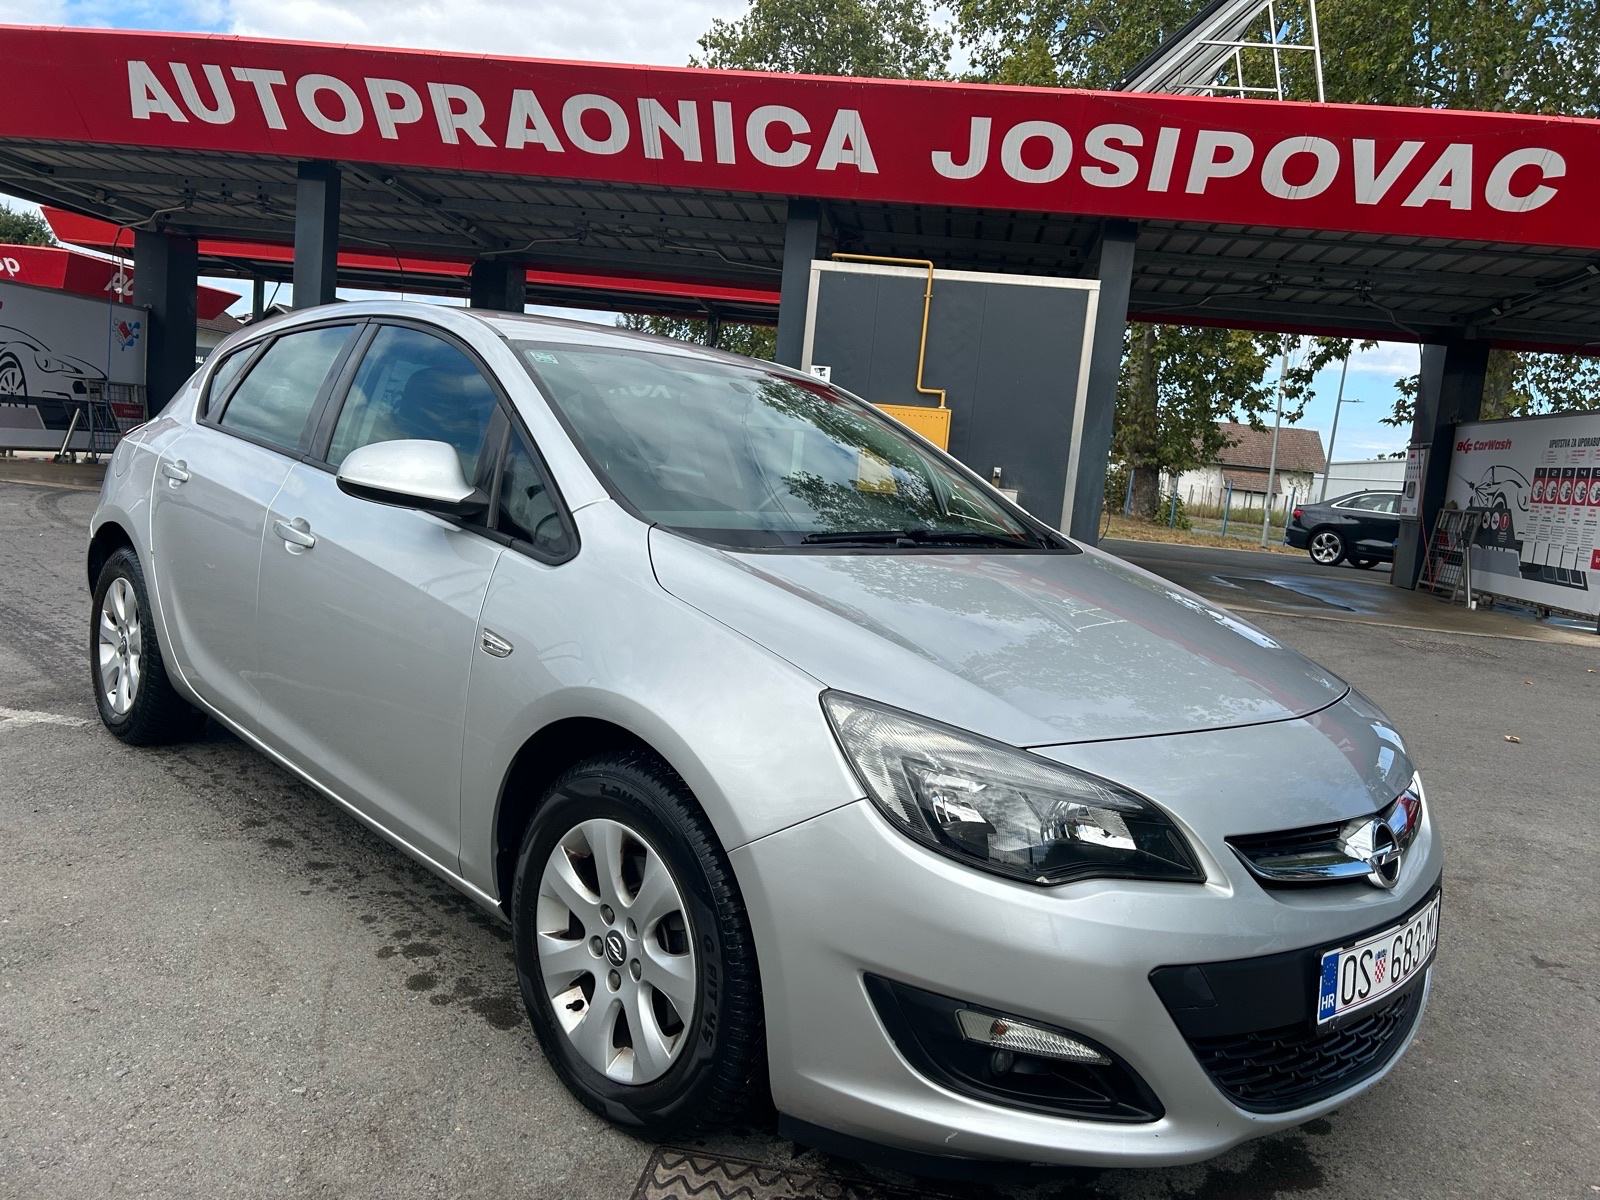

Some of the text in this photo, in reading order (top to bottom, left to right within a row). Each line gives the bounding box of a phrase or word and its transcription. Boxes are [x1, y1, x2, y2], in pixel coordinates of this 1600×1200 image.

[127, 60, 1566, 213] AUTOPRAONICA JOSIPOVAC
[1321, 994, 1335, 1011] HR
[1342, 949, 1373, 1005] OS
